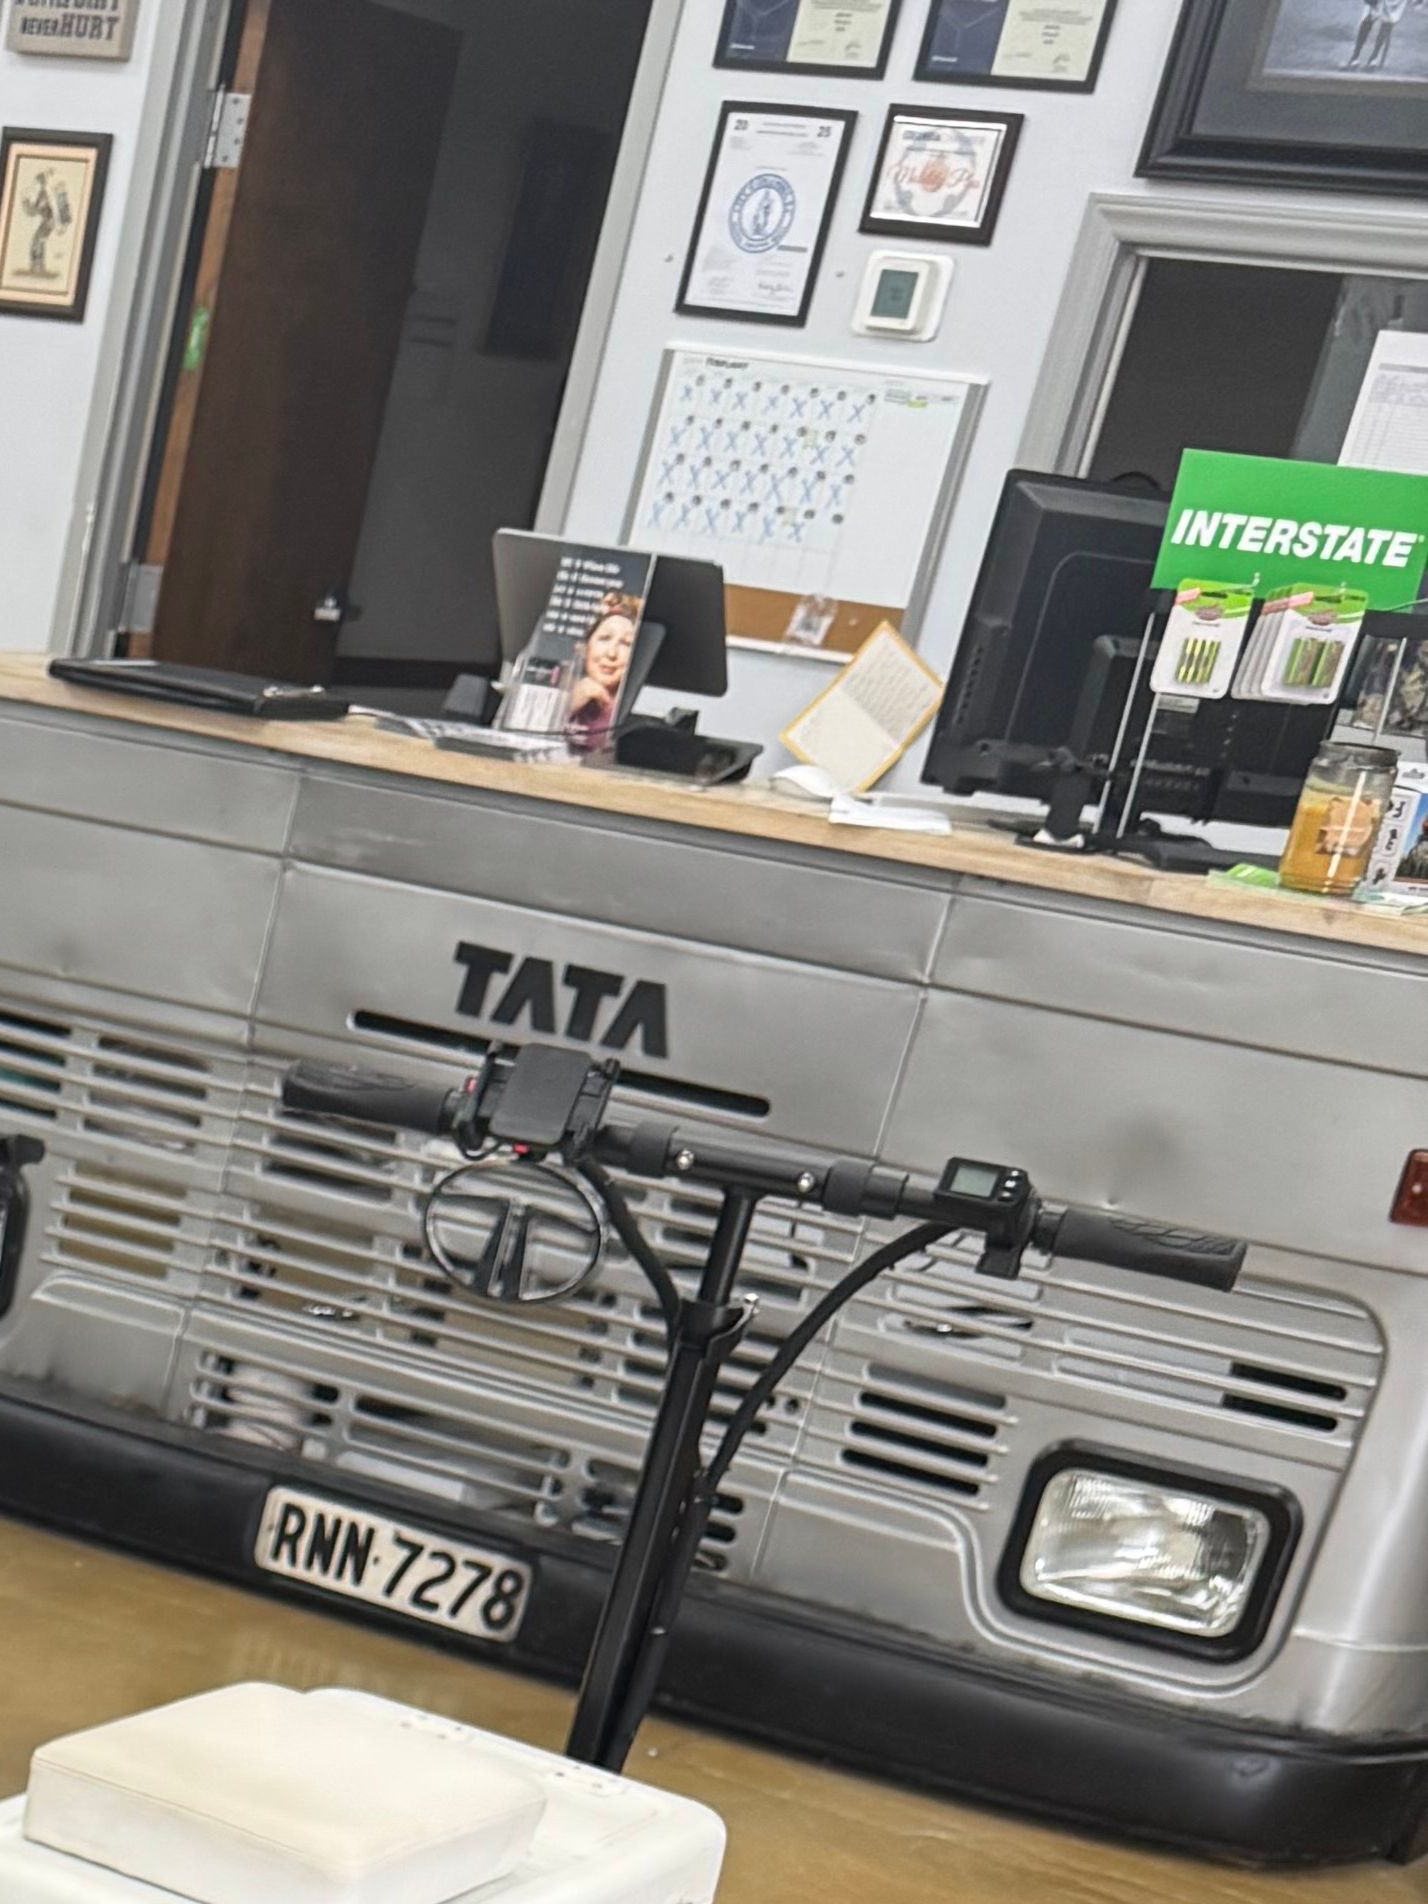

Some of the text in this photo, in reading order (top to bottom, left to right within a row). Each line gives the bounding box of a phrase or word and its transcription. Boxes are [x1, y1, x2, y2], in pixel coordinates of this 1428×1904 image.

[61, 12, 120, 40] HURT
[1171, 508, 1418, 568] INTERSTATE
[453, 940, 669, 1060] TATA
